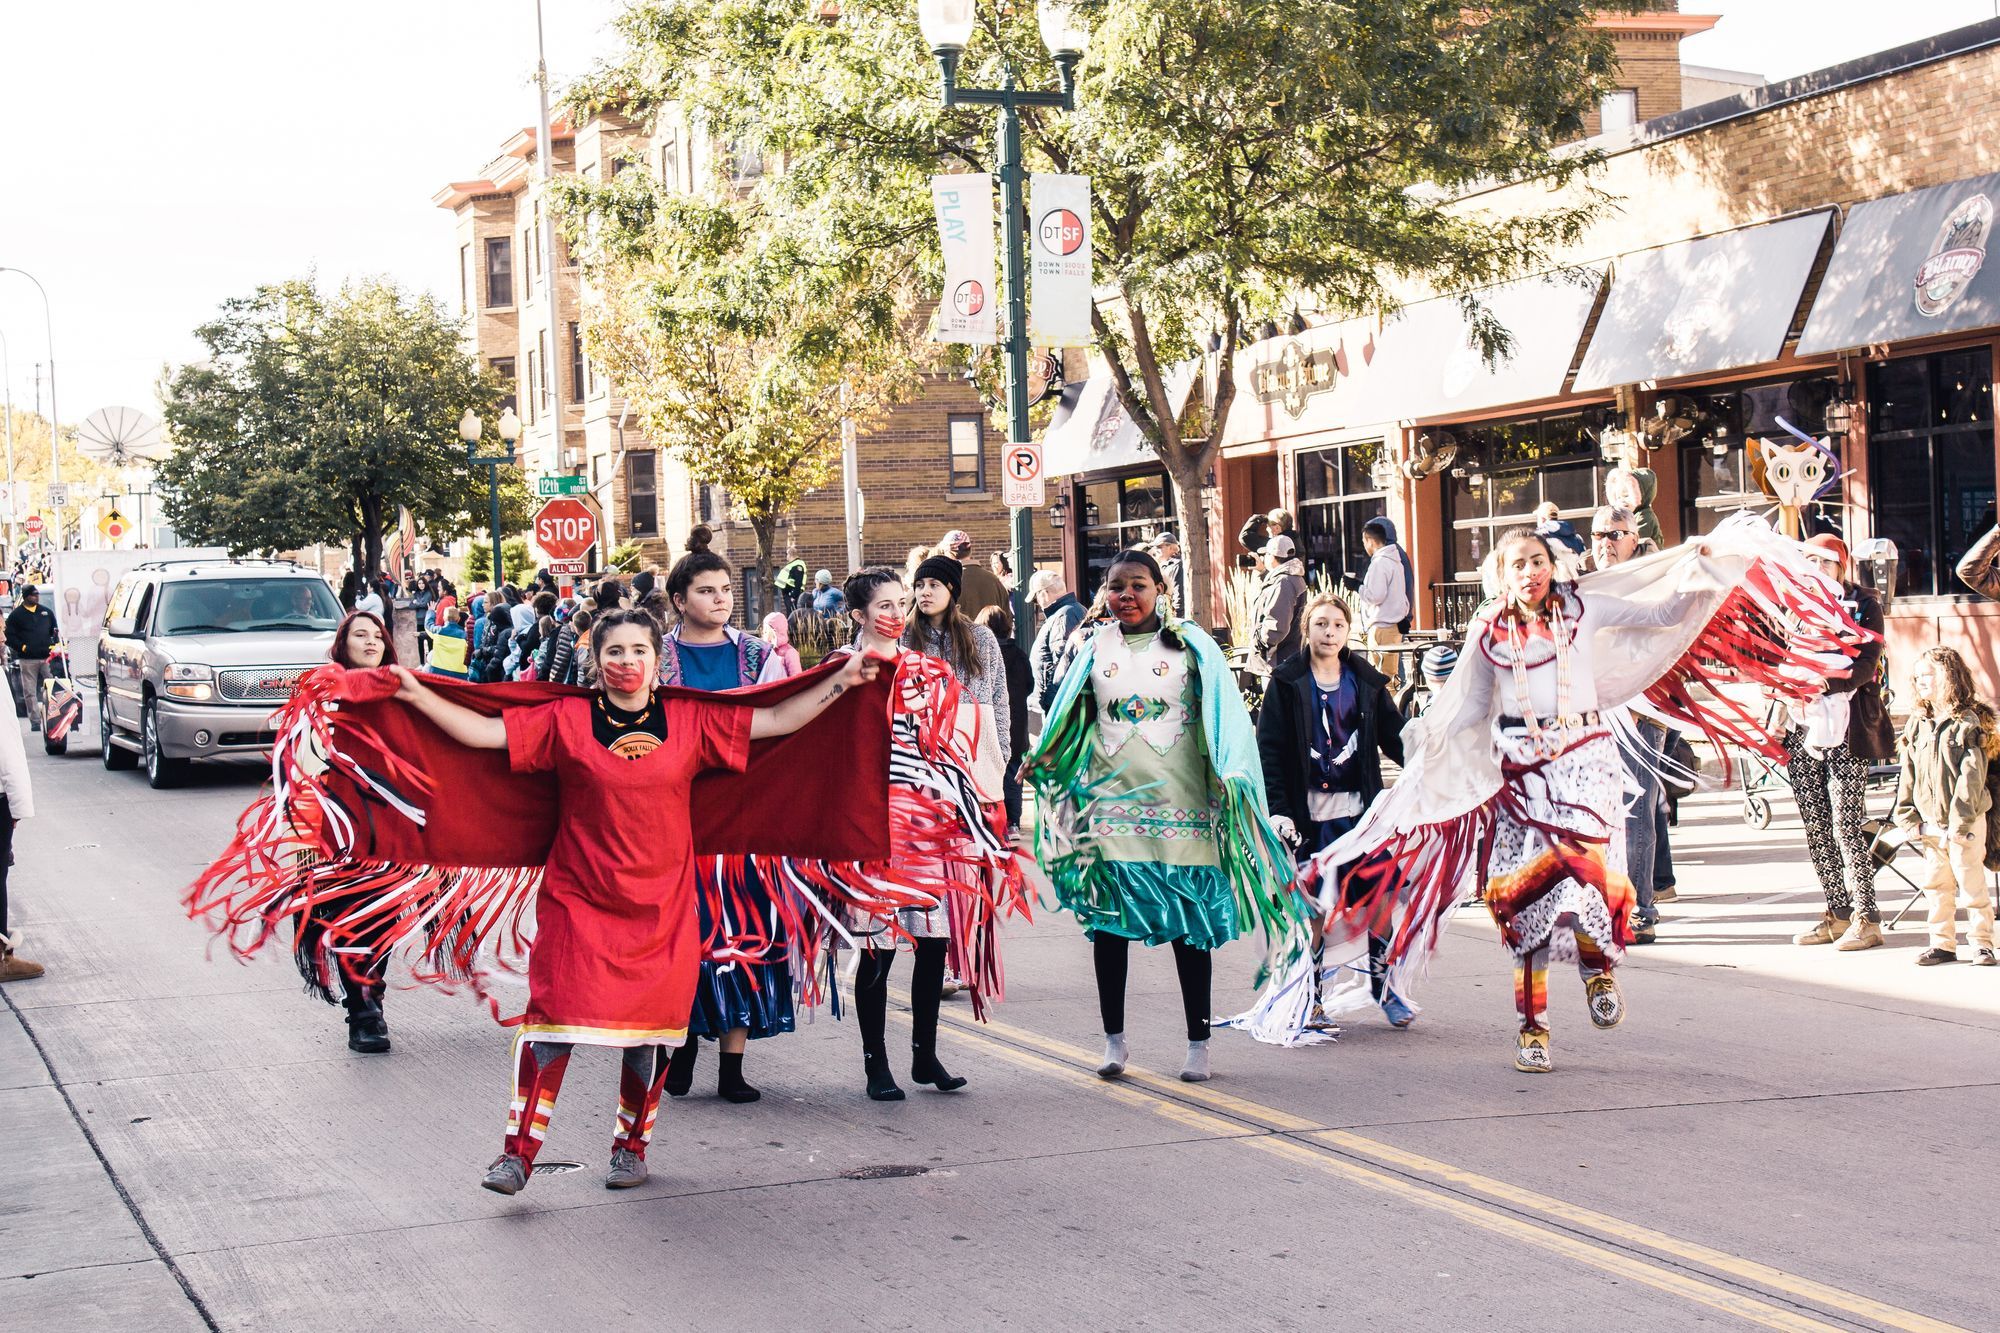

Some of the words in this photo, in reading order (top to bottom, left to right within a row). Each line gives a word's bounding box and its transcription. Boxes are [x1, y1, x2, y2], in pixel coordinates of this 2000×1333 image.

[939, 191, 967, 243] PLAY
[1044, 226, 1080, 241] DTSF
[957, 292, 983, 305] DTSF
[1016, 453, 1033, 475] P
[540, 479, 559, 493] 12th
[578, 477, 587, 485] ST
[1015, 483, 1034, 492] THIS
[52, 495, 65, 505] 15
[1010, 493, 1038, 502] SPACE
[25, 520, 43, 530] STOP
[540, 518, 592, 542] STOP
[551, 565, 565, 573] ALL
[567, 565, 583, 573] WAY
